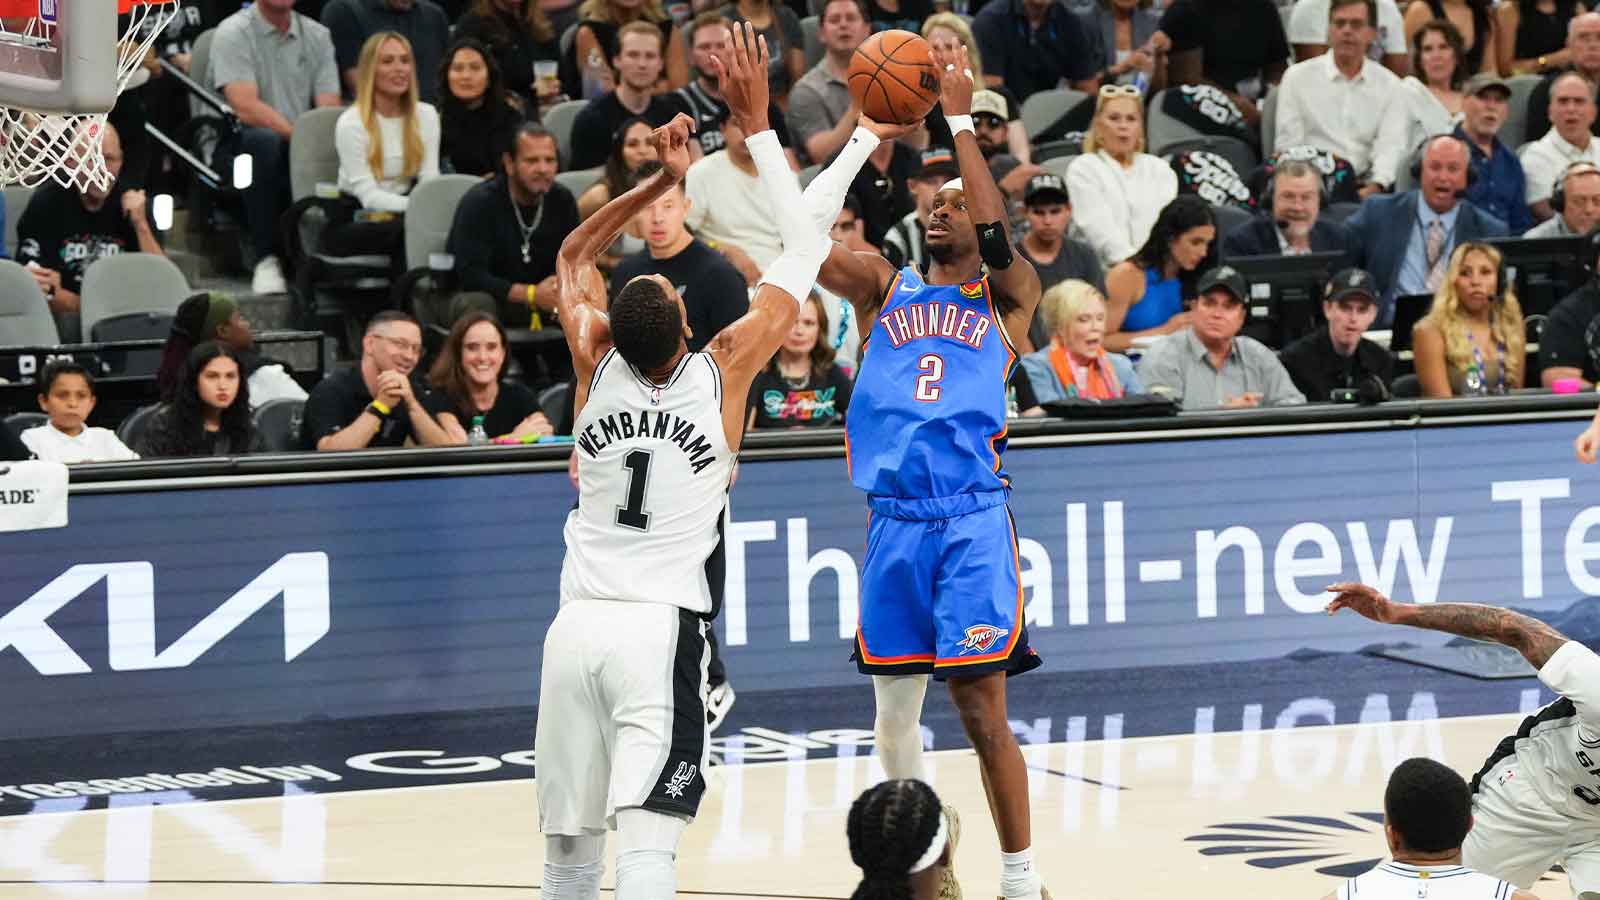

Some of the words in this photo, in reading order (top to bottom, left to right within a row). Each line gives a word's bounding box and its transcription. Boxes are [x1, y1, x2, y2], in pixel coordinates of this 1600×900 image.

[880, 302, 992, 349] THUNDER
[914, 352, 946, 402] 2
[577, 410, 717, 475] WEMBANYAMA
[615, 447, 654, 533] 1
[724, 517, 859, 646] Th
[966, 631, 993, 648] OKC
